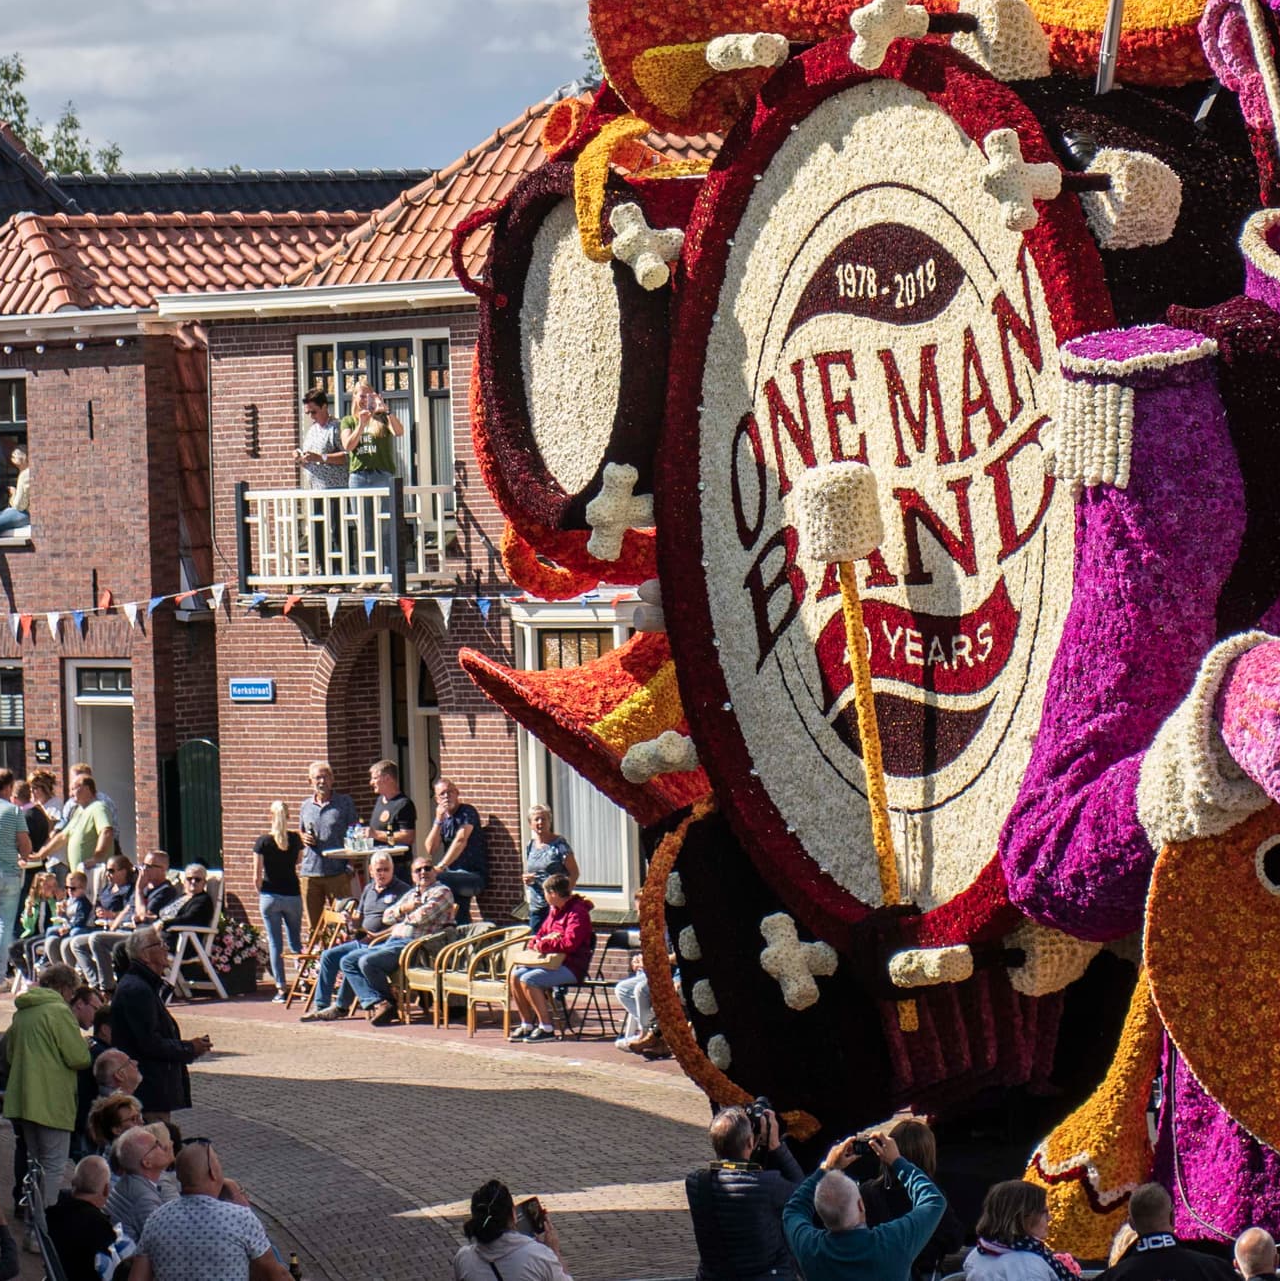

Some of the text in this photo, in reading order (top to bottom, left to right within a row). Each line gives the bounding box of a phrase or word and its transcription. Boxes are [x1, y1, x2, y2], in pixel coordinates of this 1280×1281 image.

[731, 239, 1044, 551] ONE MAN
[743, 415, 1056, 676] BND
[882, 620, 994, 670] YEARS
[232, 685, 269, 695] Kerkstraat
[1135, 1234, 1177, 1252] JCB
